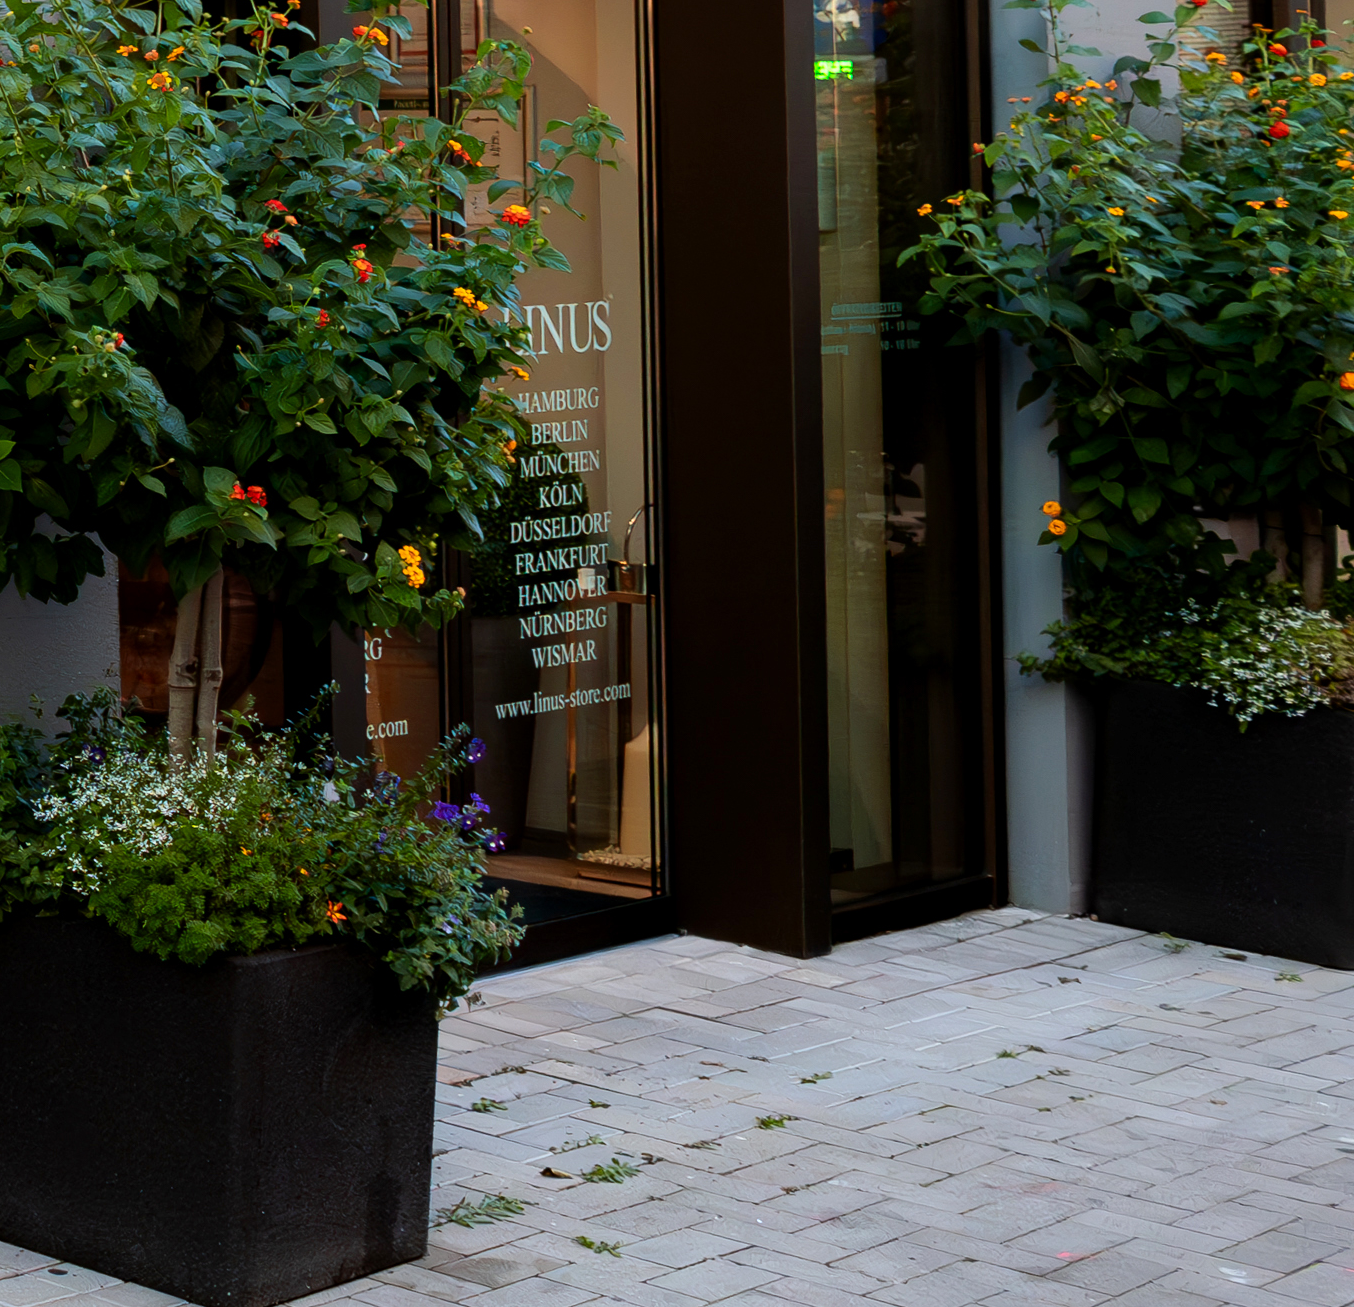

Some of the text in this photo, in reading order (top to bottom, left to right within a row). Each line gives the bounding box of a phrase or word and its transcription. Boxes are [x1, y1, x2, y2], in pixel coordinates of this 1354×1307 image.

[518, 386, 600, 414] HAMBURG
[531, 419, 588, 445] BERLIN
[519, 449, 601, 479] MÜNCHEN
[539, 480, 583, 509] KÖLN
[510, 510, 612, 544] DÜSSELDORF
[515, 543, 609, 576] FRANKFURT
[518, 574, 609, 607] HANNOVER
[519, 606, 608, 639] NÜRNBERG
[531, 640, 598, 669] WISMAR
[495, 682, 631, 720] www.linus-store.com
